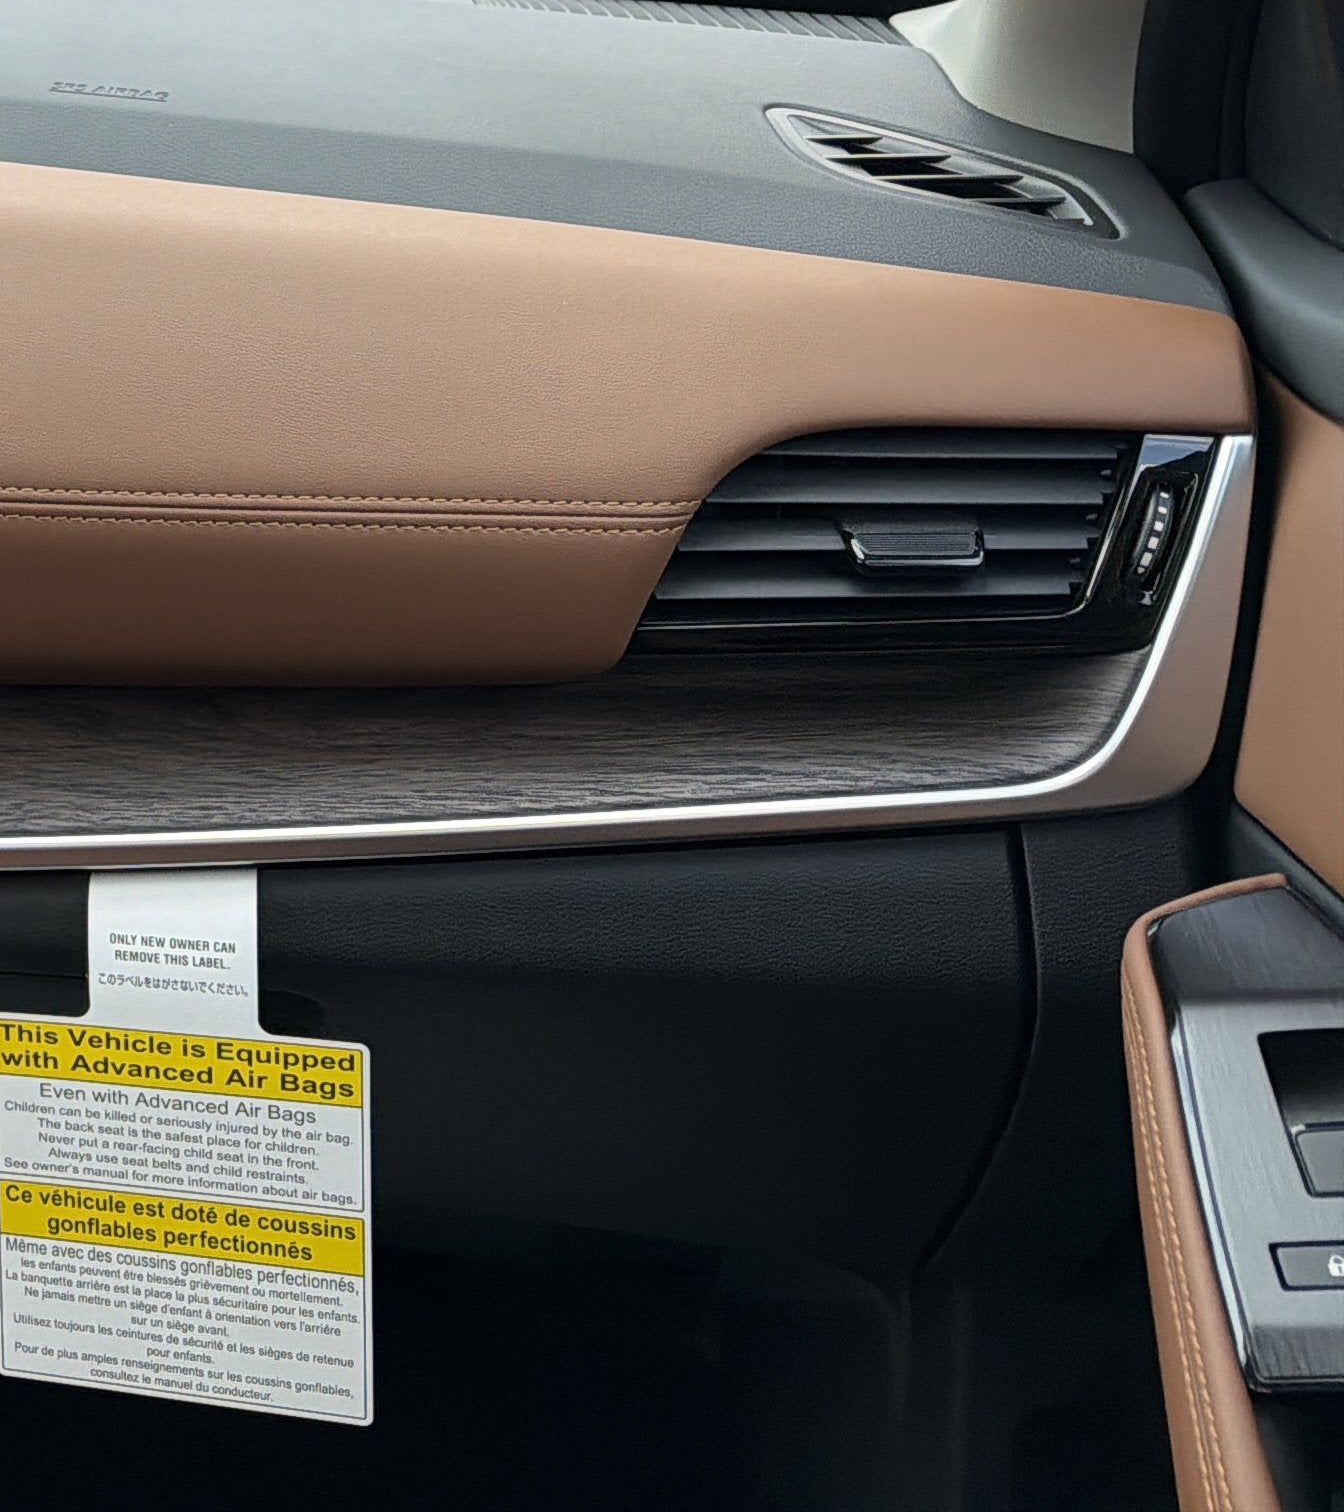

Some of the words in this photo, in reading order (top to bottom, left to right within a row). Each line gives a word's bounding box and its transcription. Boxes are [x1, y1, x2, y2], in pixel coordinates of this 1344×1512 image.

[109, 932, 137, 947] ONLY
[140, 935, 165, 948] NEW
[169, 937, 209, 952] OWNER
[213, 939, 236, 954] CAN
[114, 949, 160, 964] REMOVE
[163, 952, 188, 966] THIS
[192, 955, 231, 970] LABEL.
[66, 1028, 172, 1056] Vehicle
[182, 1038, 206, 1059] is
[216, 1041, 355, 1072] Equipped
[0, 1049, 59, 1070] with
[70, 1054, 213, 1085] Advanced
[224, 1068, 269, 1089] Air
[280, 1072, 355, 1101] Bags
[3, 1099, 56, 1115] Children
[58, 1107, 82, 1118] can
[85, 1107, 101, 1120] be
[104, 1109, 137, 1124] killed
[139, 1115, 154, 1125] or
[156, 1116, 213, 1133] seriously
[215, 1120, 259, 1136] injured
[262, 1124, 279, 1140] by
[281, 1127, 303, 1140] the
[305, 1129, 323, 1142] air
[325, 1131, 354, 1148] bag.
[39, 1082, 86, 1102] Even
[91, 1088, 129, 1106] with
[134, 1091, 229, 1116] Advanced
[234, 1101, 262, 1119] Air
[267, 1104, 317, 1127] Bags
[36, 1116, 62, 1130] The
[64, 1119, 95, 1134] back
[97, 1125, 125, 1137] seat
[127, 1126, 139, 1138] is
[141, 1128, 162, 1141] the
[164, 1131, 204, 1145] safest
[206, 1134, 241, 1148] place
[244, 1137, 262, 1150] for
[264, 1140, 320, 1157] children.
[38, 1131, 76, 1146] Never
[78, 1137, 99, 1149] put
[101, 1140, 110, 1149] a
[112, 1141, 180, 1159] rear-facing
[183, 1146, 213, 1160] child
[216, 1152, 245, 1164] seat
[247, 1152, 259, 1165] in
[262, 1154, 283, 1168] the
[286, 1156, 319, 1171] front.
[5, 1184, 33, 1204] Ce
[38, 1189, 127, 1214] véhicule
[132, 1201, 165, 1219] est
[171, 1202, 218, 1225] doté
[224, 1208, 251, 1228] de
[257, 1216, 357, 1241] coussins
[47, 1217, 157, 1242] gonflables
[163, 1230, 313, 1261] perfectionnés
